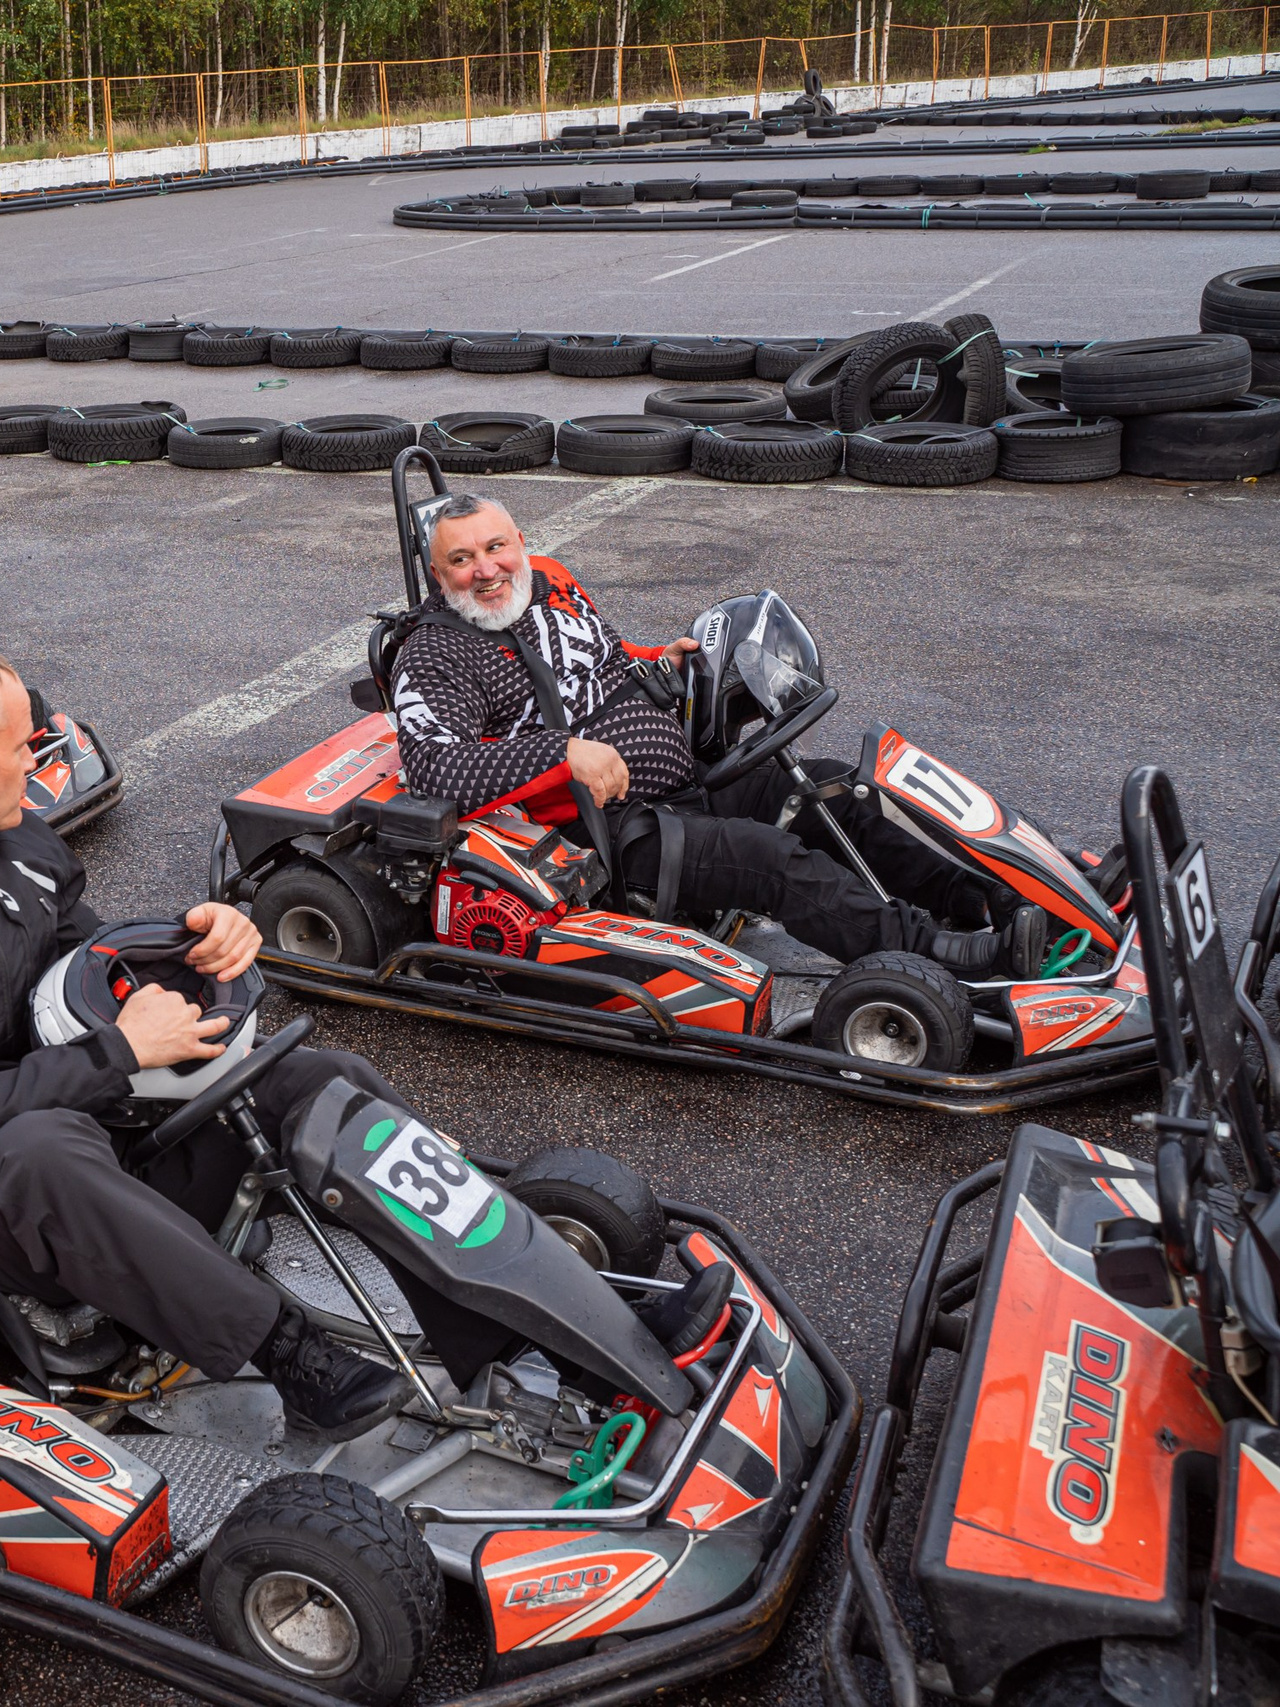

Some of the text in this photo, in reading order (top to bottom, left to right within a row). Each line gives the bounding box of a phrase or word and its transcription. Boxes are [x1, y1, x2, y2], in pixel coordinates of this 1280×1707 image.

[705, 616, 721, 647] SHOEI
[306, 742, 392, 798] DINO
[902, 755, 973, 821] 17
[1186, 870, 1206, 943] 6
[474, 937, 500, 949] GX
[583, 918, 741, 969] DINO
[1031, 1003, 1092, 1024] DINO
[388, 1136, 470, 1216] 38
[1037, 1356, 1067, 1454] KART
[1053, 1323, 1126, 1526] DINO
[508, 1566, 611, 1604] DINO
